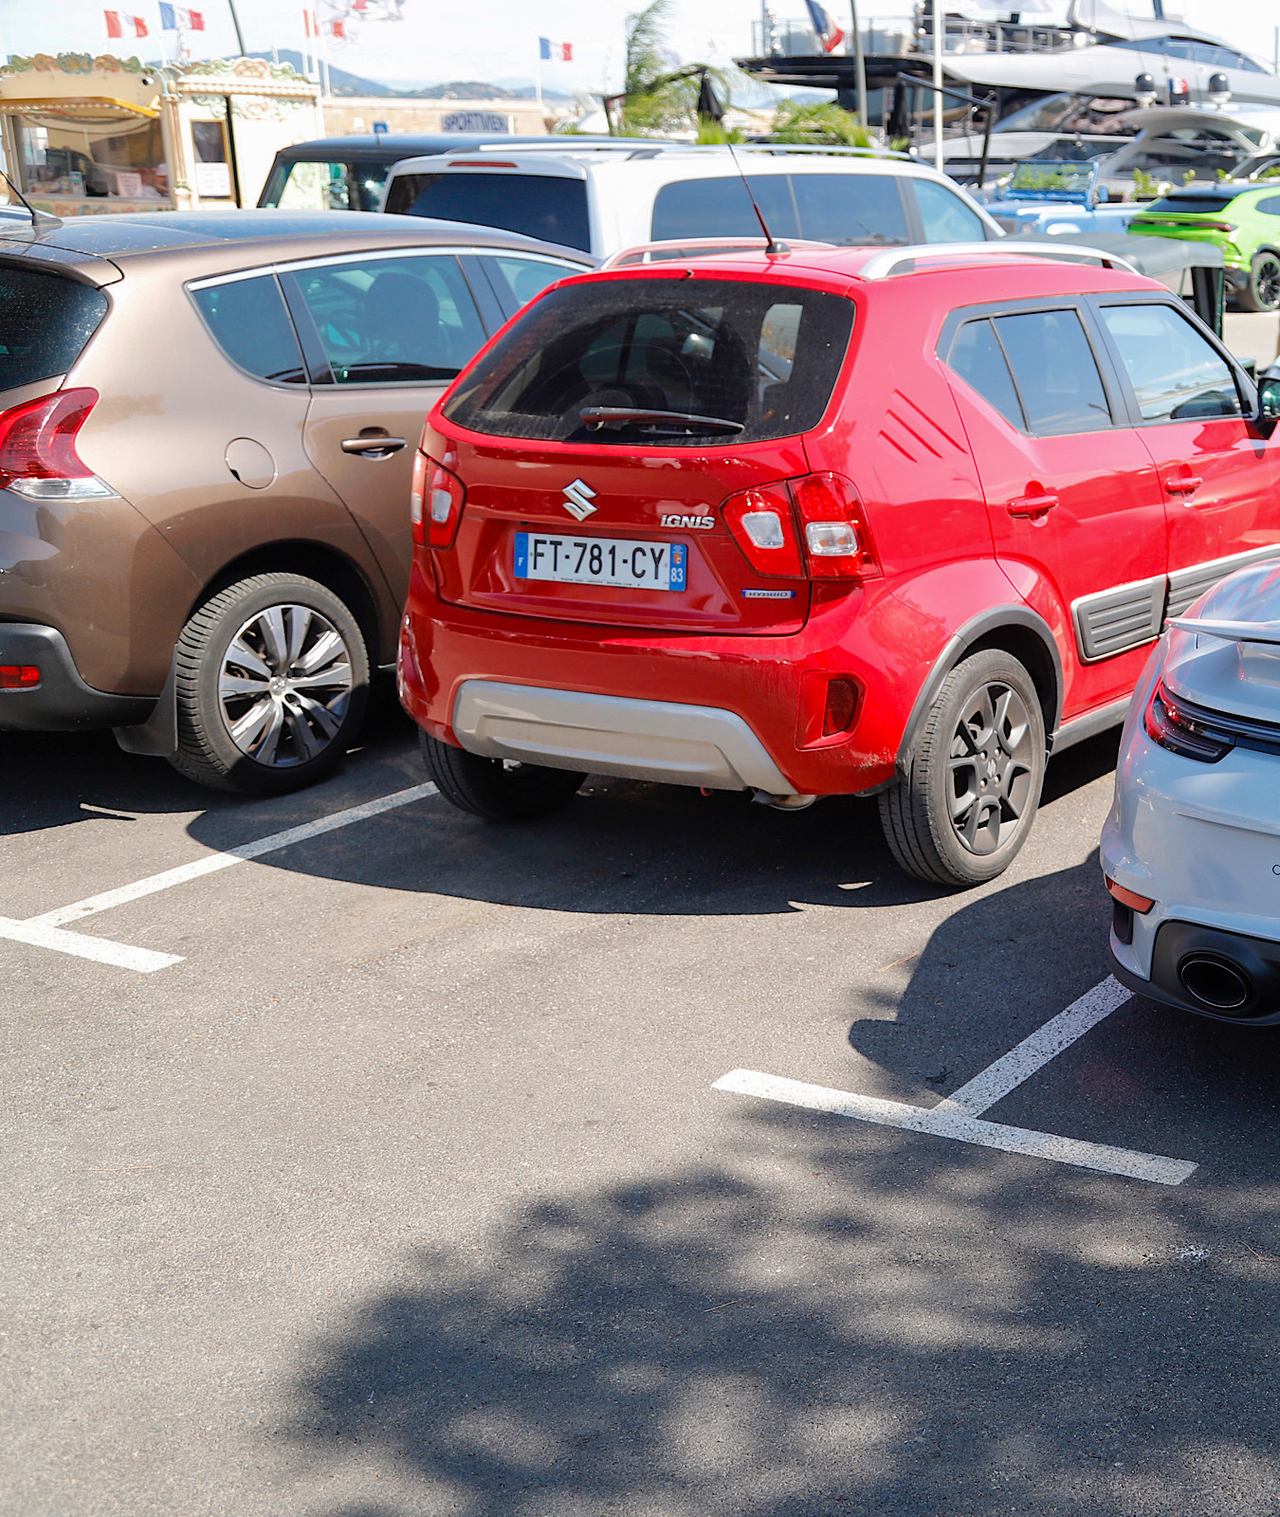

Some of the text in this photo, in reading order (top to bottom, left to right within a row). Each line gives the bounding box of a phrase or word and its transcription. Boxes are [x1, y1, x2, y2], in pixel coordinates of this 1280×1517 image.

[660, 514, 715, 529] IGNIS
[533, 538, 665, 581] FT-781-CY
[670, 567, 684, 583] 83
